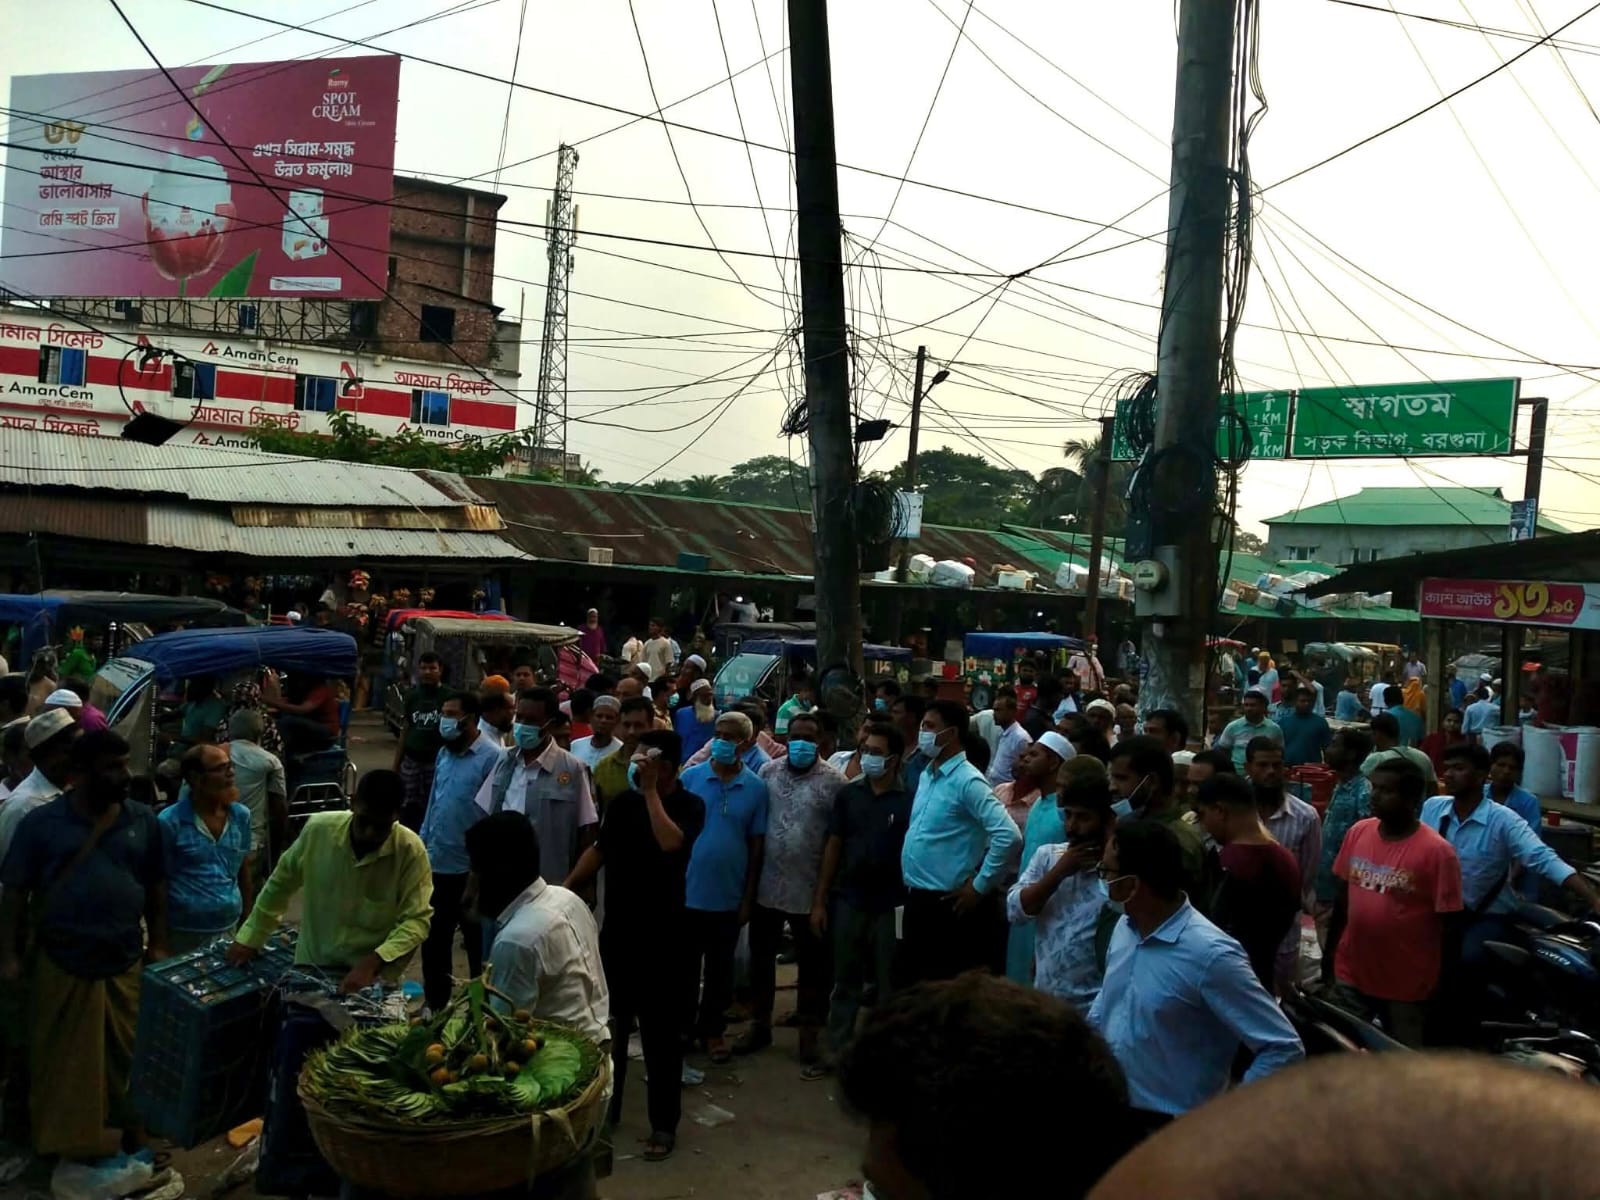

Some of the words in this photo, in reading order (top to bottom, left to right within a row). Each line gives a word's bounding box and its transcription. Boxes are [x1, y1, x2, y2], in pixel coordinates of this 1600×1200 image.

[322, 92, 357, 106] SPOT
[311, 104, 361, 121] CREAM
[252, 142, 283, 158] এখন
[284, 139, 356, 160] সিরাম-সমৃদ্ধ
[274, 160, 304, 178] উন্নত
[38, 183, 113, 200] ভালোবাসার
[40, 209, 63, 226] রেমি
[91, 208, 117, 226] ক্রিম
[47, 322, 105, 349] সিমেন্ট
[222, 345, 299, 366] AmanCem
[8, 381, 94, 401] AmanCem
[393, 370, 442, 390] আমান
[446, 372, 493, 396] সিমেন্ট
[189, 404, 244, 425] আমান
[1342, 393, 1457, 419] স্বাগতম
[1261, 411, 1282, 426] KM
[416, 425, 482, 442] AmanCem
[1263, 444, 1284, 457] KM
[1304, 435, 1348, 453] সড়ক
[1424, 591, 1454, 605] ক্যাশ
[1456, 591, 1492, 606] আউট
